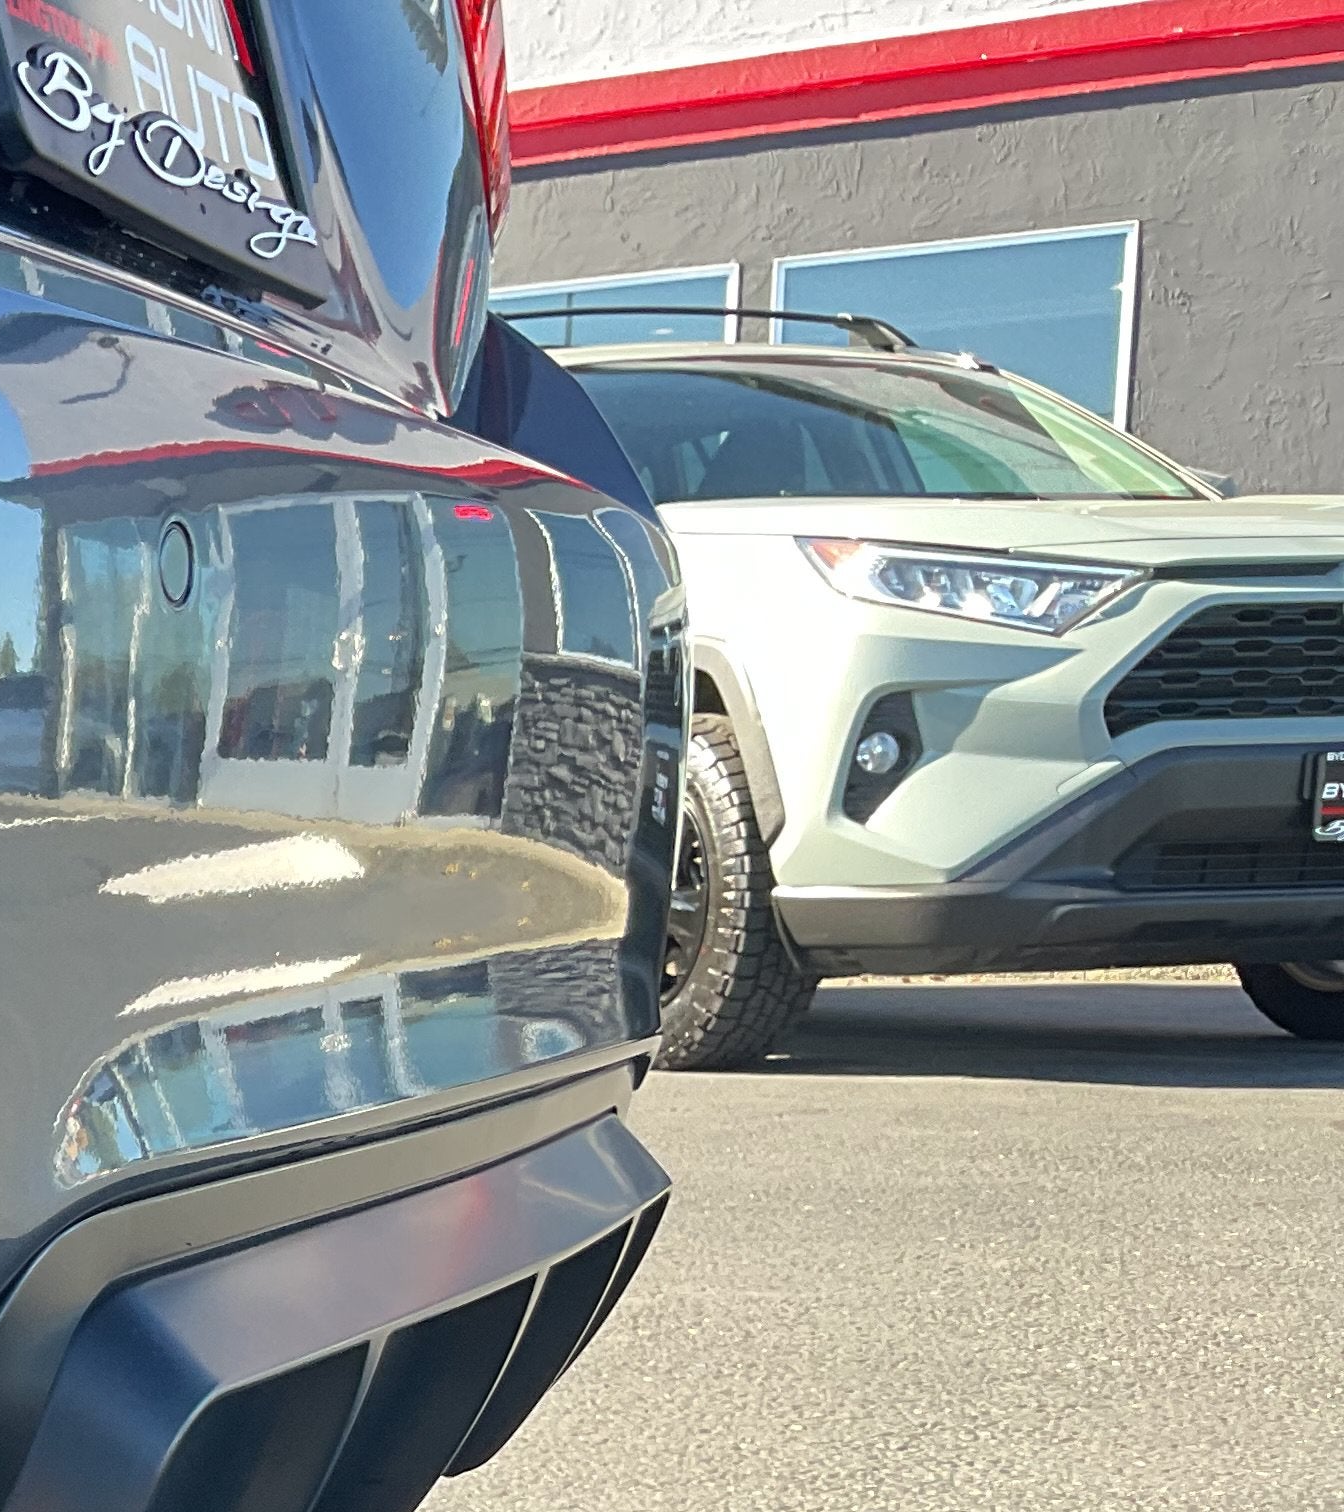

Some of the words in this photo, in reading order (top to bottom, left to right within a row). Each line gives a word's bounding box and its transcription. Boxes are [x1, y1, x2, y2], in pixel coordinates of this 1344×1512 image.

[17, 51, 126, 176] By
[134, 119, 318, 259] Design
[125, 24, 276, 181] AUTO
